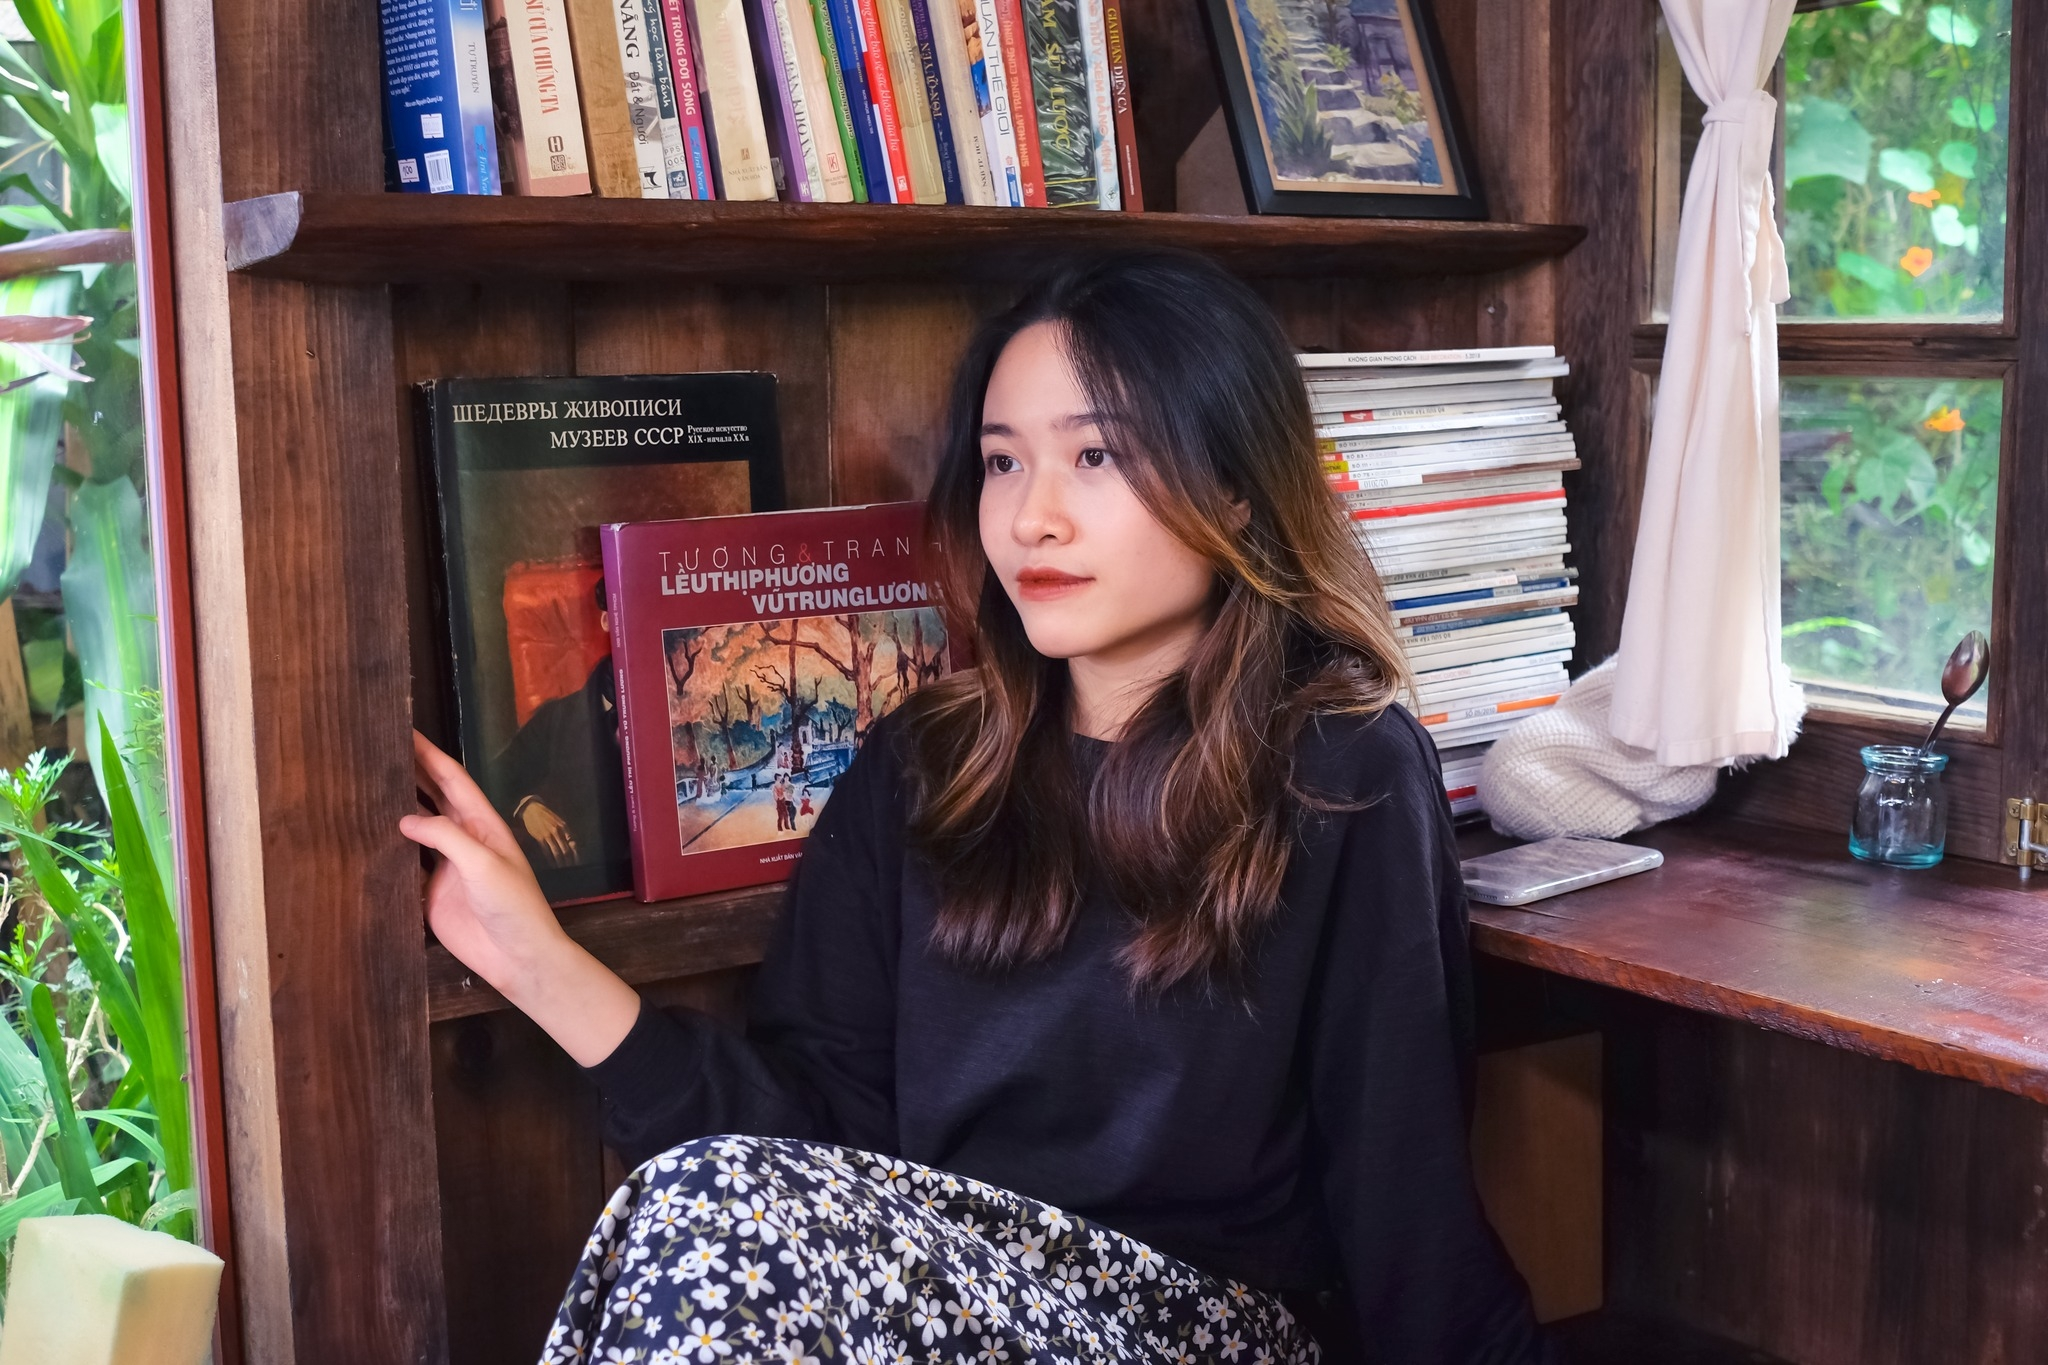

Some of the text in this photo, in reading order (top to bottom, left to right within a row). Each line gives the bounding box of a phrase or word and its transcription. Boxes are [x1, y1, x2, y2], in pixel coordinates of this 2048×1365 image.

[528, 17, 554, 43] CỦA
[649, 18, 659, 42] học
[671, 15, 687, 56] TRONG
[900, 5, 915, 60] CONSCIOUS
[533, 46, 559, 93] CHÚNG
[654, 47, 666, 72] làm
[678, 57, 692, 80] ĐỜI
[628, 71, 643, 93] Đất
[866, 18, 877, 38] thức
[878, 72, 887, 89] sức
[886, 113, 896, 137] mùa
[1094, 62, 1105, 93] XEM
[540, 94, 560, 114] TA
[632, 96, 643, 105] &
[658, 76, 671, 108] bánh
[681, 81, 697, 116] SỐNG
[1010, 76, 1023, 110] TRONG
[1118, 96, 1128, 114] CA
[632, 107, 650, 145] Người
[1018, 143, 1030, 168] SINH
[693, 150, 706, 191] First News
[1348, 354, 1368, 363] KHÔNG
[1403, 354, 1417, 362] CÁCH
[452, 398, 683, 425] ШЕДЕВРЫ ЖИВОПИСИ
[550, 427, 684, 449] МУЗЕЕВ СССР
[687, 425, 748, 435] Русское искусство
[1363, 479, 1389, 488] 02/2010
[658, 543, 786, 572] TƯỢNG
[798, 542, 812, 563] &
